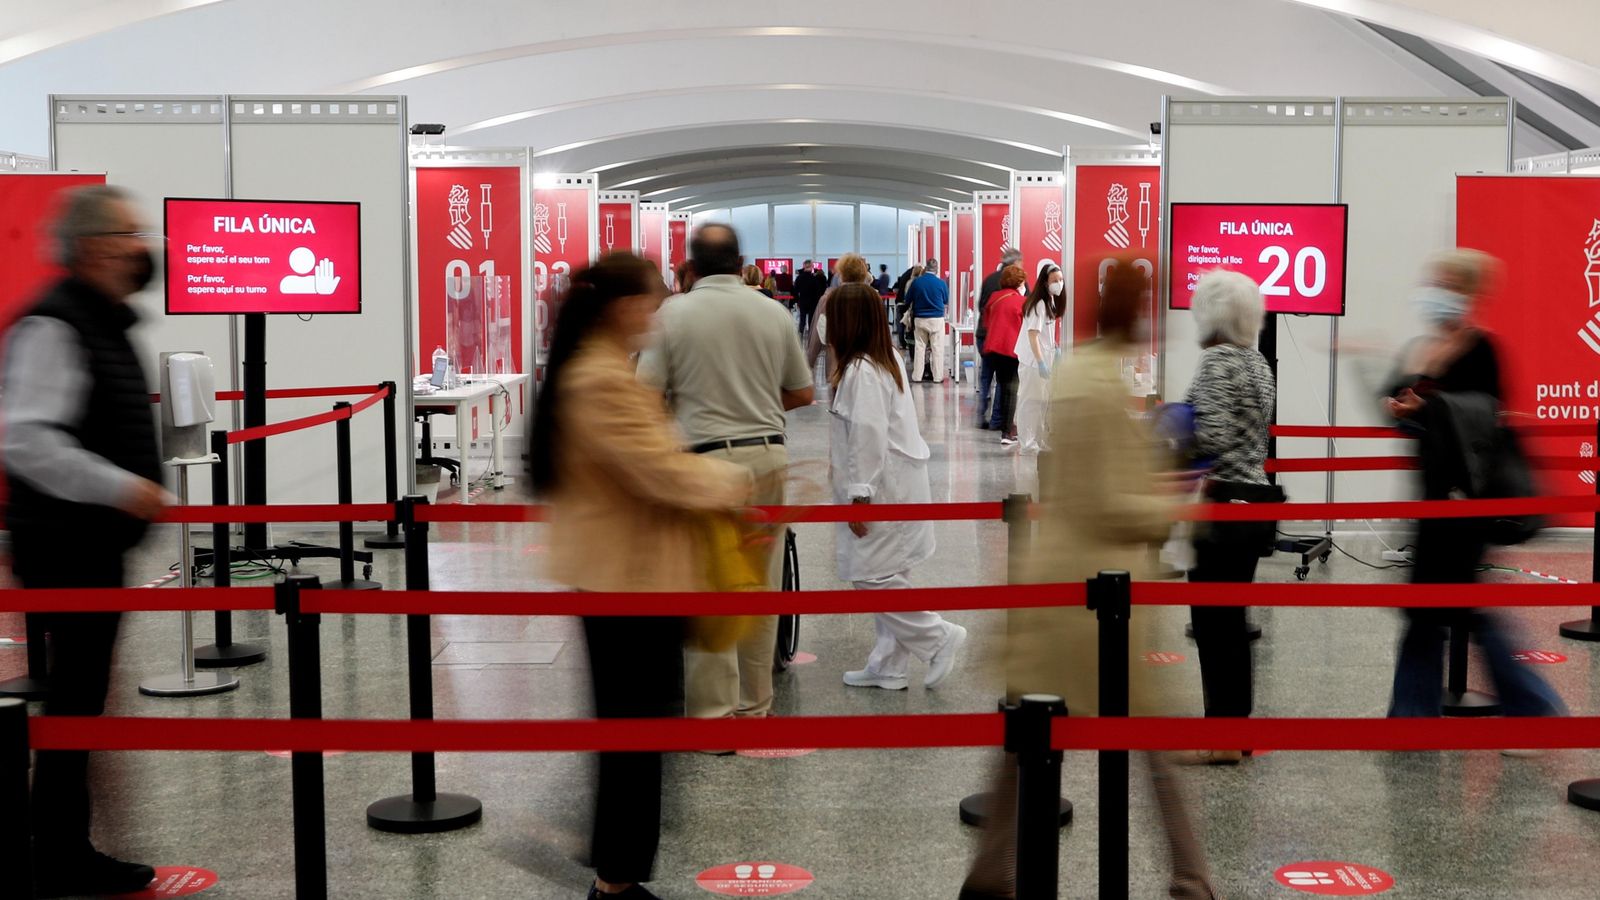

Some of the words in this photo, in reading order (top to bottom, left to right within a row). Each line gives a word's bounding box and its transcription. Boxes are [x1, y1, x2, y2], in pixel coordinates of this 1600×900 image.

[214, 216, 255, 233] FILA
[259, 213, 316, 234] ÚNICA
[1220, 221, 1249, 235] FILA
[1251, 219, 1294, 236] ÚNICA
[186, 244, 201, 253] Per
[202, 244, 225, 254] favor,
[1188, 245, 1200, 253] Per
[1201, 245, 1220, 255] favor,
[186, 256, 215, 265] espere
[229, 255, 237, 264] el
[1222, 255, 1229, 264] al
[1229, 255, 1243, 264] lloc
[1258, 245, 1327, 298] 20
[187, 274, 202, 283] Por
[203, 274, 226, 284] favor,
[445, 259, 495, 299] 01
[187, 286, 215, 295] espere
[216, 285, 234, 295] aquí
[245, 285, 267, 294] turno
[1536, 380, 1581, 401] punt
